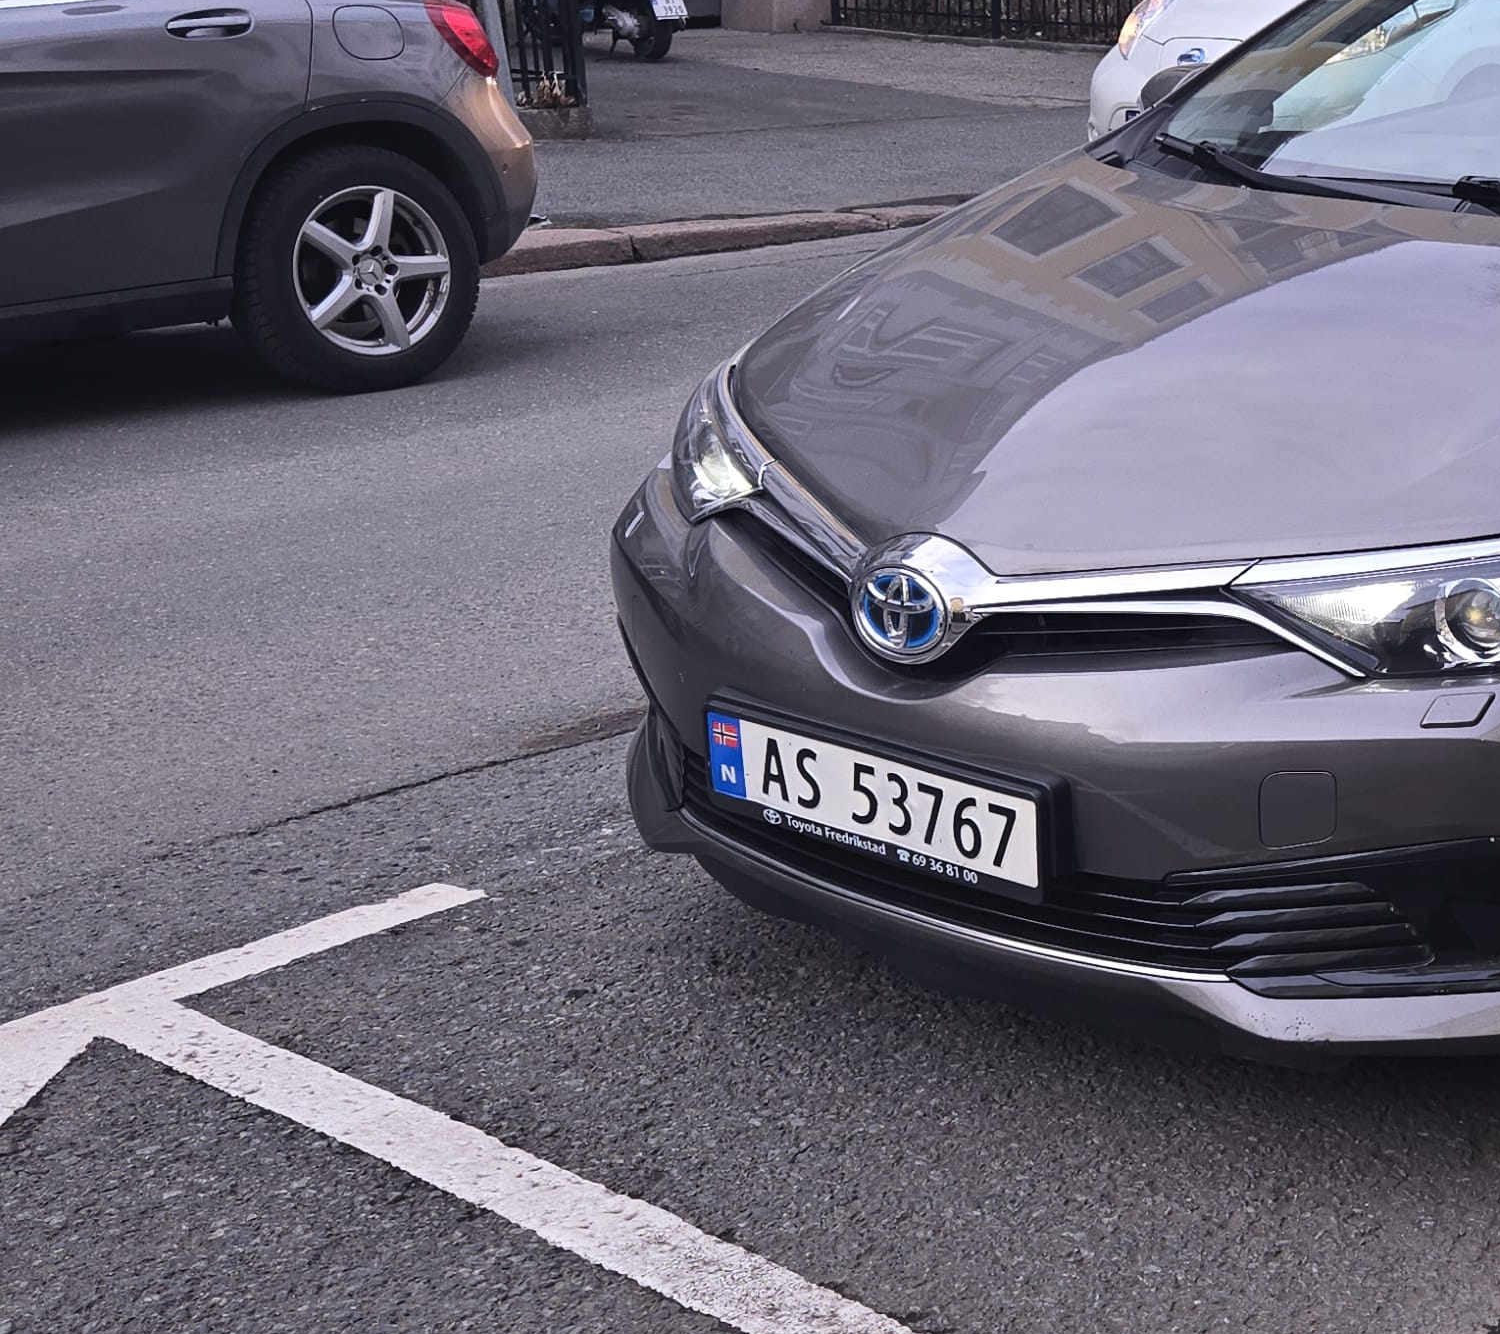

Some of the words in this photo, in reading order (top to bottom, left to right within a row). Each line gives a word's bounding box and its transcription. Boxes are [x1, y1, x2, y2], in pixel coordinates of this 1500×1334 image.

[720, 764, 736, 784] N
[762, 737, 821, 809] AS
[851, 762, 1017, 868] 53767
[785, 814, 823, 837] Toyota
[824, 827, 886, 855] Fredrikstad
[912, 854, 927, 867] 69
[929, 859, 944, 874] 36
[946, 864, 959, 878] 81
[963, 869, 978, 885] 00
